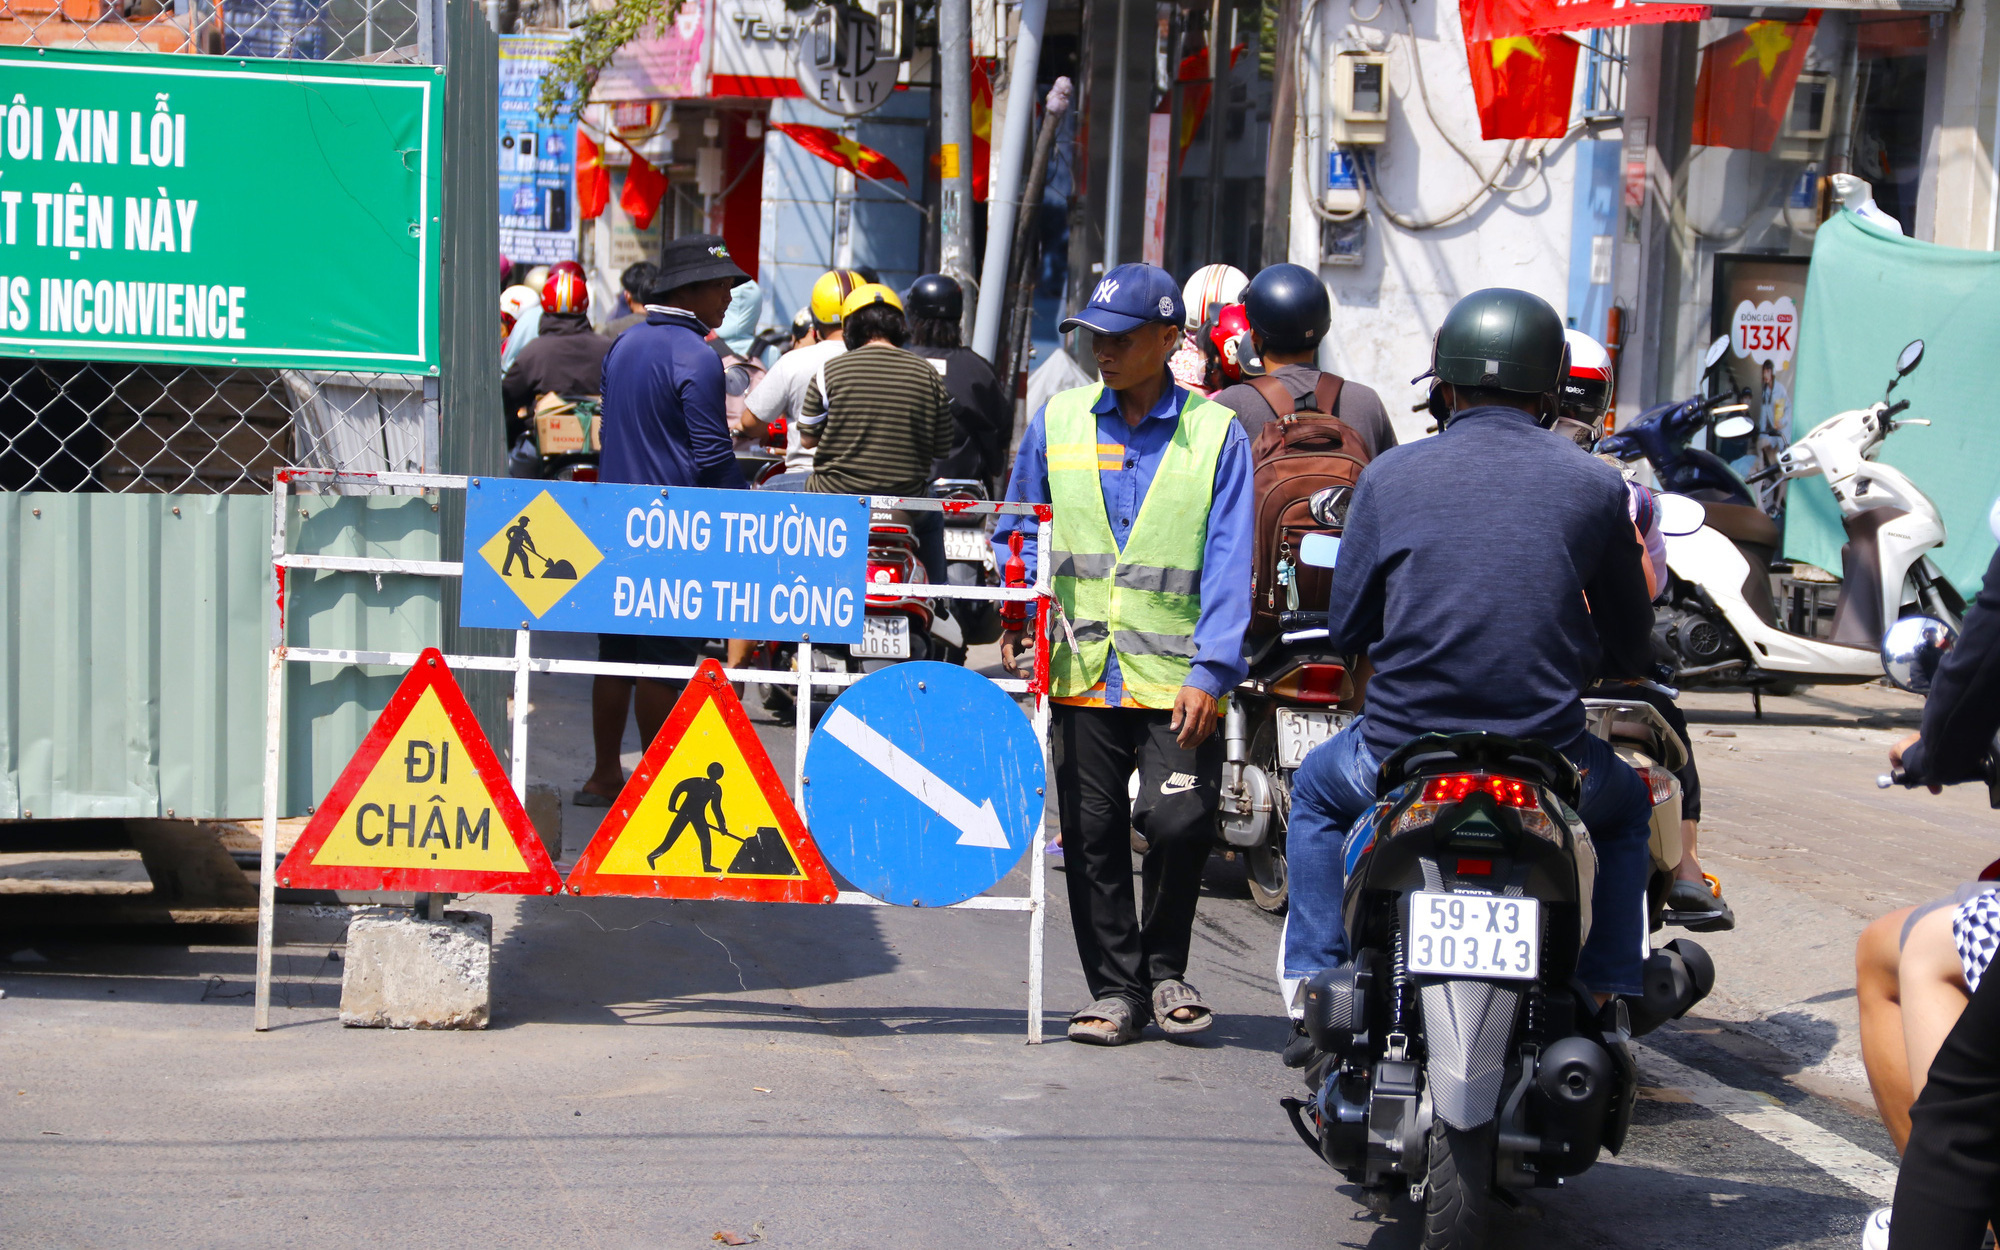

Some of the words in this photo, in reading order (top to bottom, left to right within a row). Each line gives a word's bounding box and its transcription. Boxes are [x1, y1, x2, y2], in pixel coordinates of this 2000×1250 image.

[820, 78, 878, 103] ELLY
[54, 107, 118, 164] XIN
[130, 92, 186, 167] LỖI
[0, 171, 22, 245] T
[32, 182, 113, 260] TIỆN
[125, 186, 198, 253] NÀY
[40, 278, 246, 339] INCONVIENCE
[1093, 279, 1120, 303] NY
[1740, 325, 1792, 351] 133K
[626, 498, 711, 551] CÔNG
[720, 504, 847, 558] TRƯỜNG
[871, 513, 893, 521] SYM
[946, 545, 982, 558] 92.71
[614, 576, 703, 620] ĐANG
[711, 581, 760, 623] THI
[769, 574, 854, 628] CÔNG
[404, 740, 449, 784] ĐI
[1167, 772, 1198, 788] NIKE
[356, 794, 490, 860] CHẬM
[1430, 898, 1520, 934] 59-X3
[1417, 934, 1531, 972] 303.43
